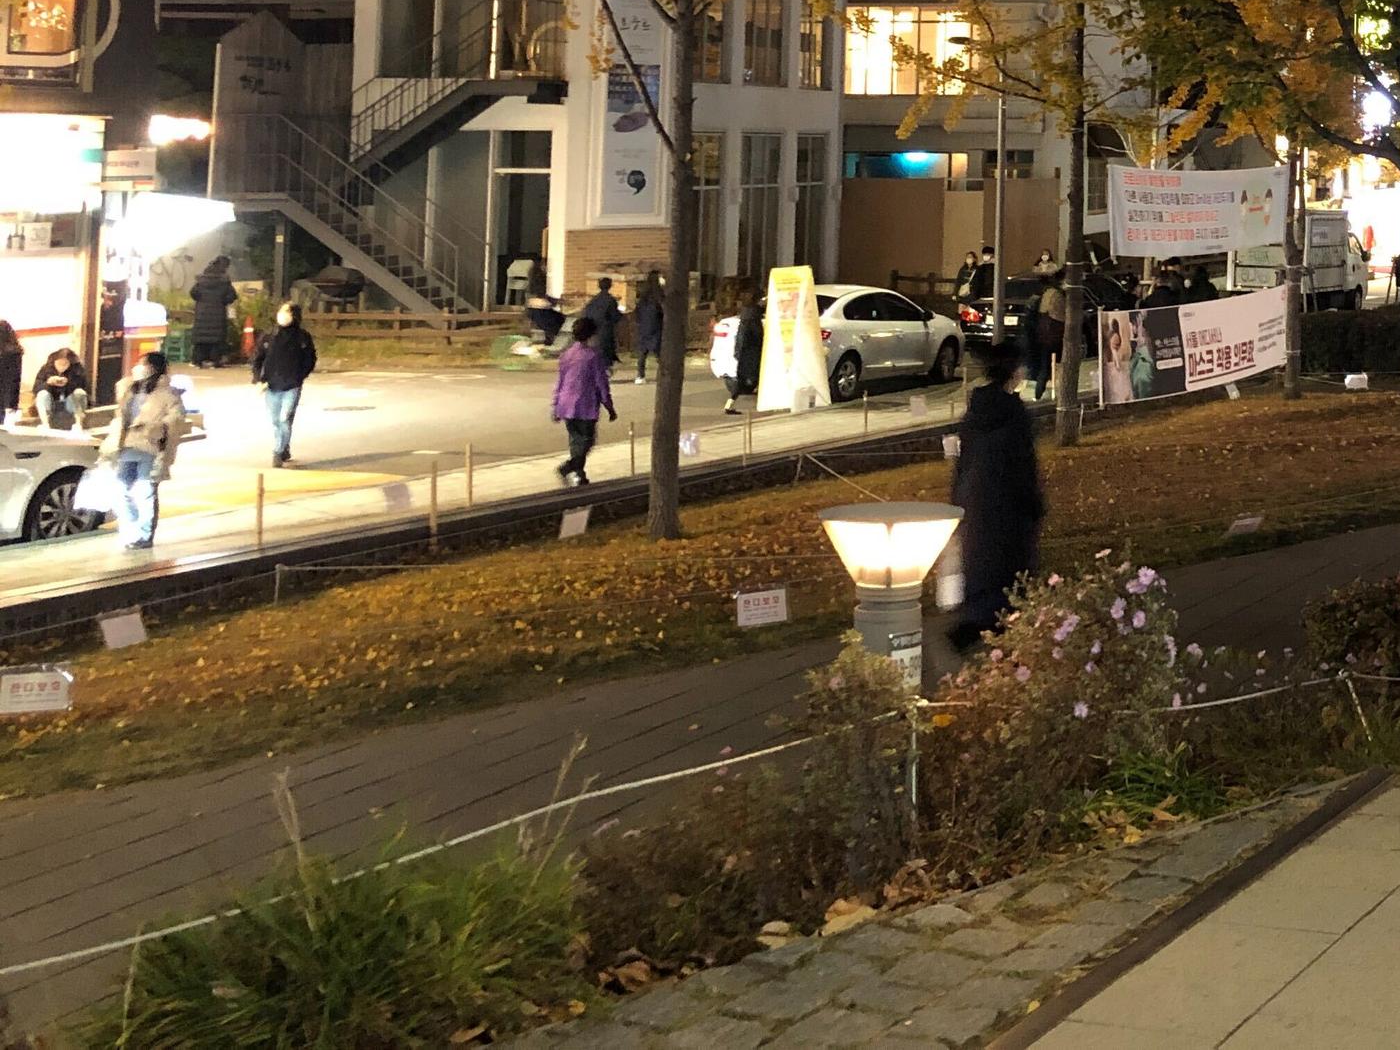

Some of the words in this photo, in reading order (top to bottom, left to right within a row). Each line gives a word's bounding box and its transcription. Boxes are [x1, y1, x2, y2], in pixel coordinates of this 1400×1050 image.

[1188, 350, 1214, 377] 마스크
[1216, 346, 1232, 371] 착용
[1233, 340, 1255, 367] 의무화
